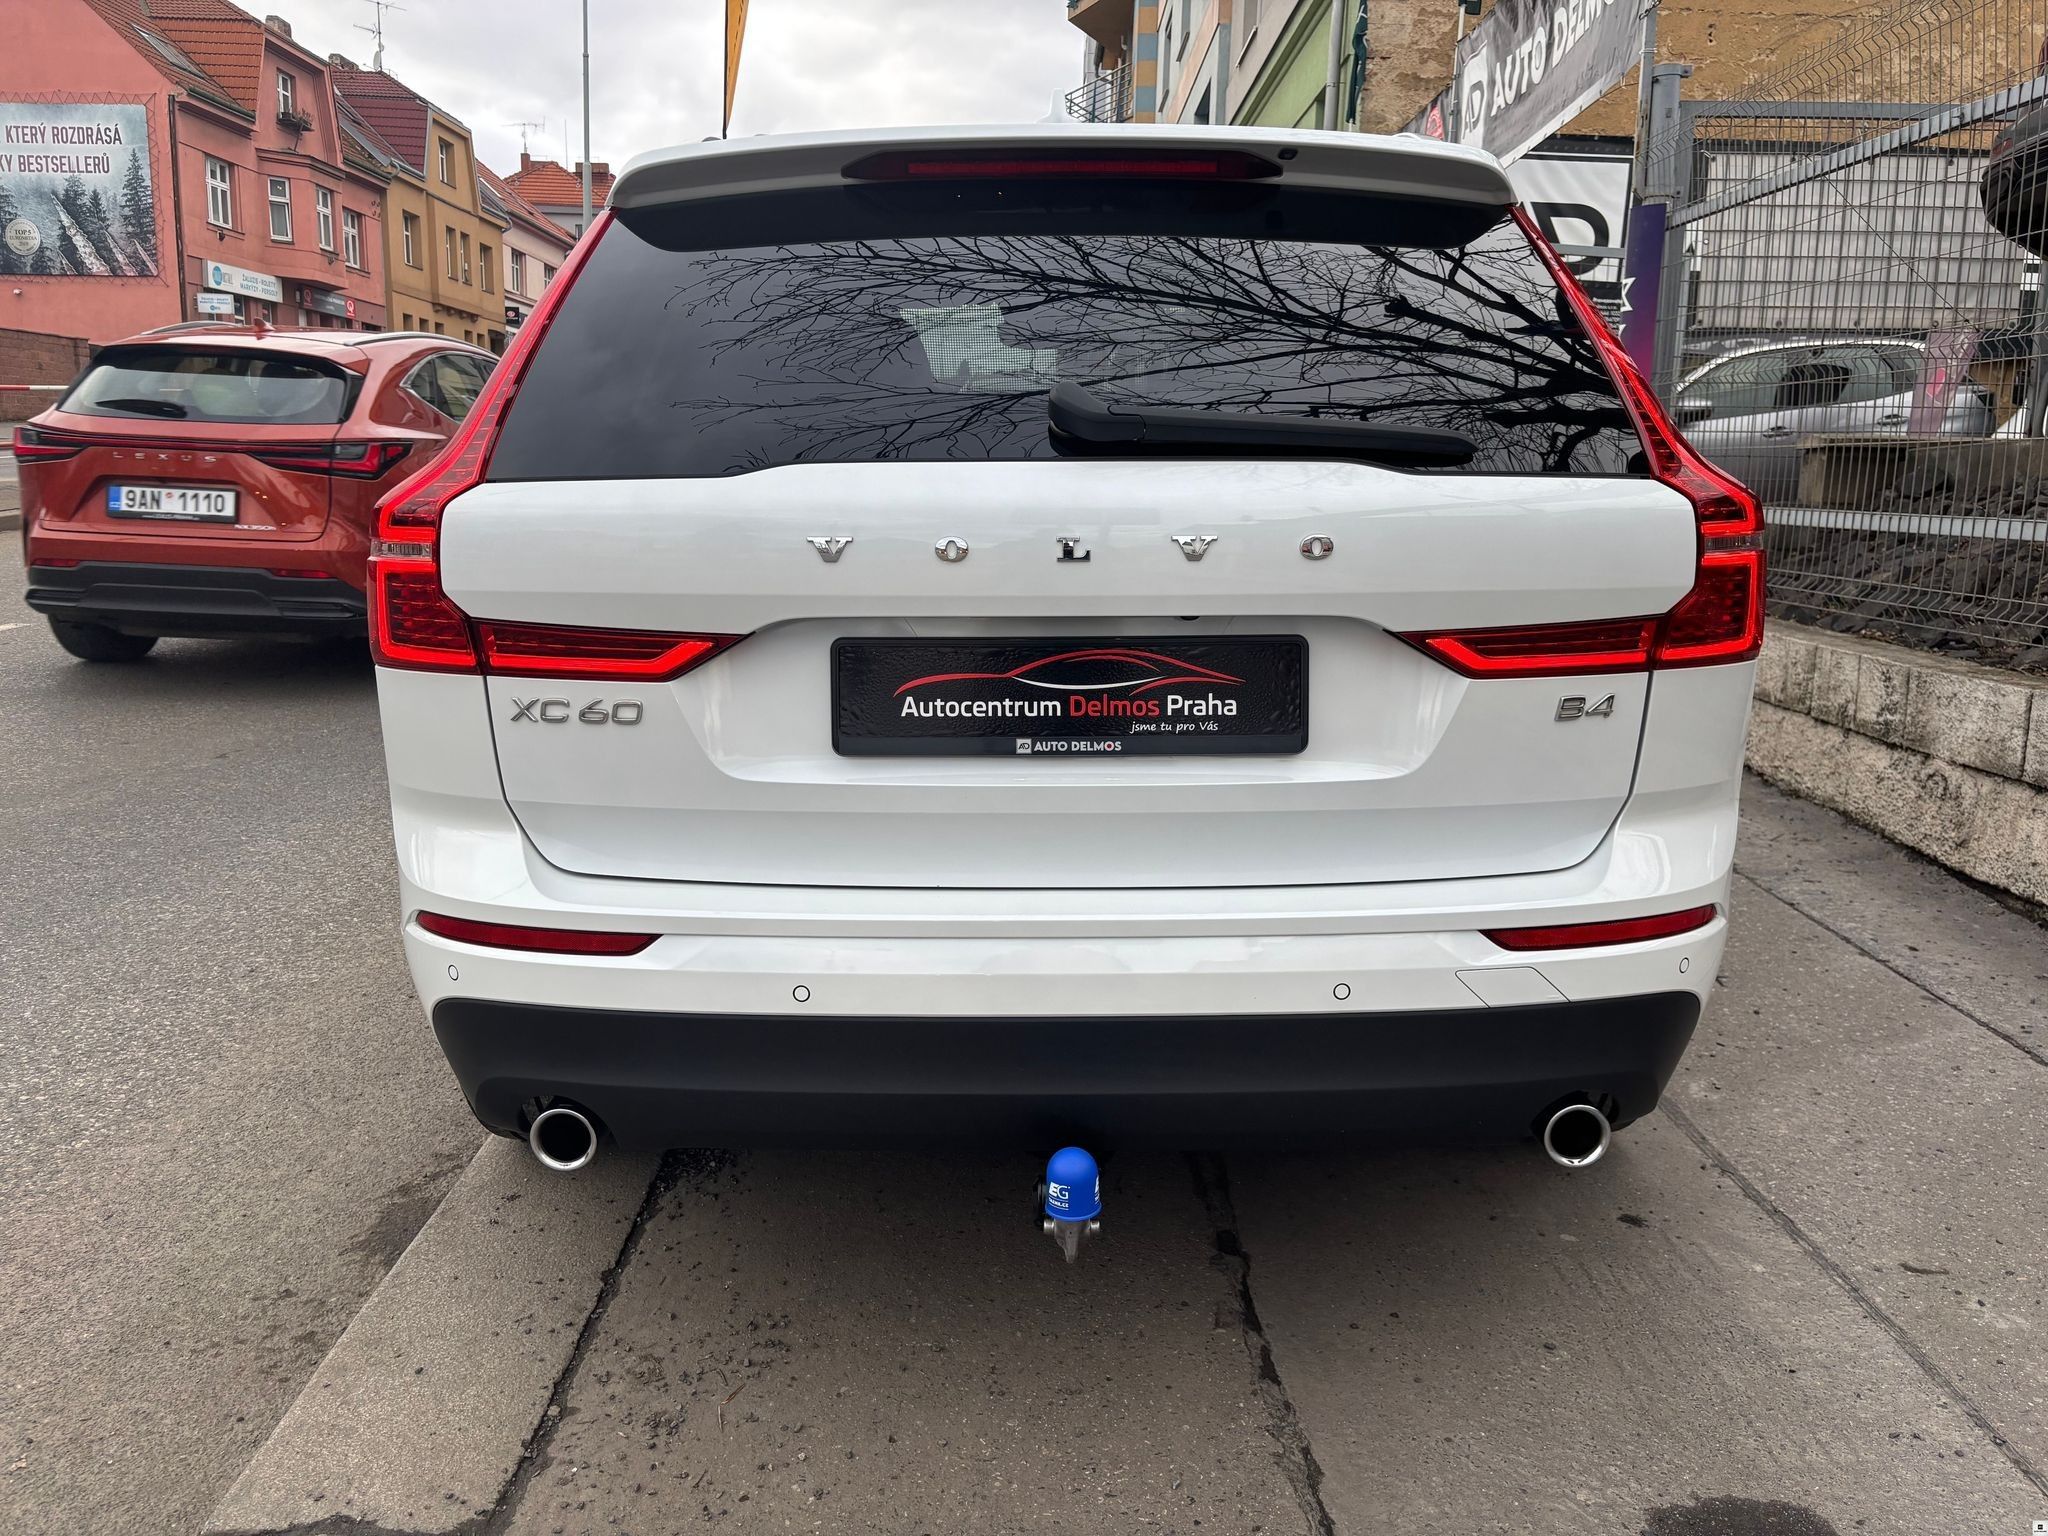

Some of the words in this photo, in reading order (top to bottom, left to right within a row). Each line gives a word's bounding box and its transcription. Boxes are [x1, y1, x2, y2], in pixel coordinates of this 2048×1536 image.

[1490, 26, 1547, 117] AUTO
[1552, 0, 1615, 68] DELM
[5, 122, 46, 144] KTERÝ
[51, 123, 122, 145] ROZDRÁSÁ
[18, 152, 110, 174] BESTSELLERŮ
[112, 452, 217, 463] LEXUS
[125, 490, 162, 510] 9AN
[178, 492, 225, 513] 1110
[806, 534, 1335, 563] VOLVO
[901, 696, 1062, 717] Autocentrum
[1069, 693, 1160, 717] Delmos
[1167, 692, 1237, 716] Praha
[1554, 692, 1615, 722] B4
[1129, 721, 1157, 734] jsme
[1160, 721, 1172, 731] tu
[1176, 724, 1195, 734] pro
[1200, 721, 1219, 731] Vás
[1033, 741, 1068, 751] AUTO
[1071, 741, 1122, 752] DELMOS
